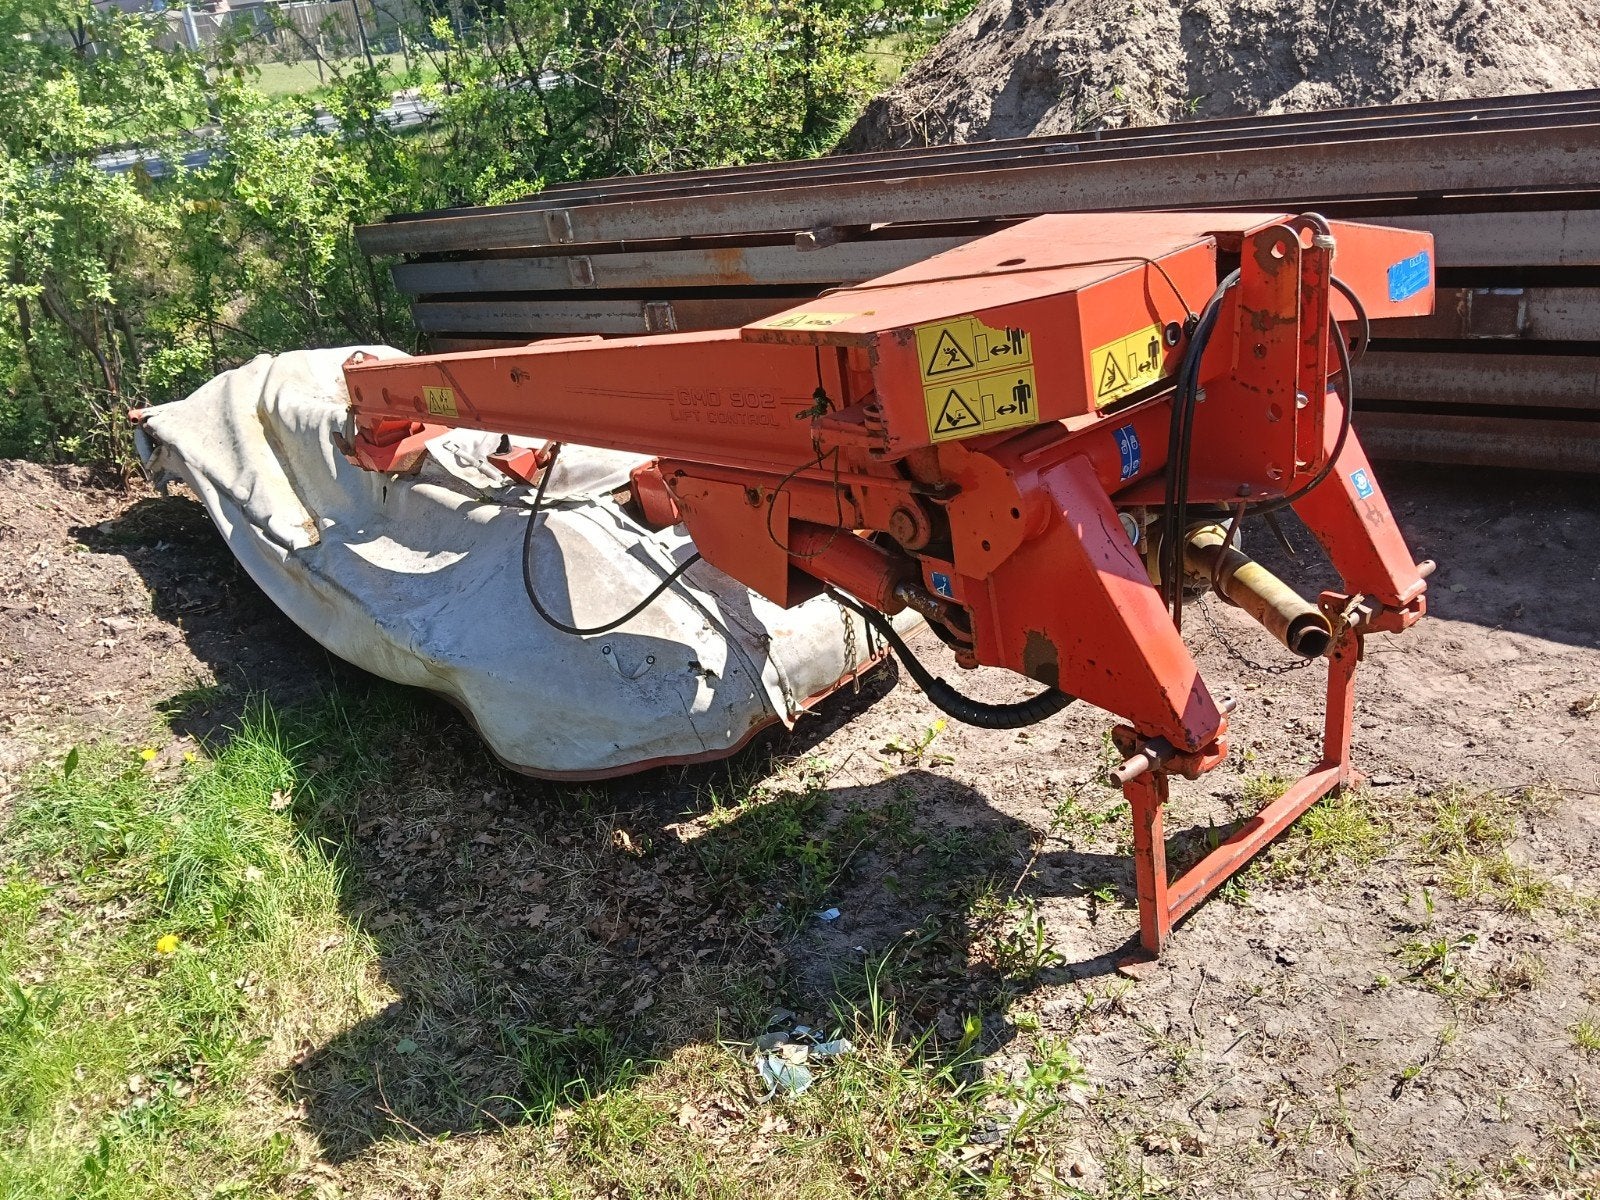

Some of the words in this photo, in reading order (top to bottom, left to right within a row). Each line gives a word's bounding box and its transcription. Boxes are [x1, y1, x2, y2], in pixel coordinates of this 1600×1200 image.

[678, 390, 721, 407] GMD
[729, 392, 776, 409] 902
[670, 409, 701, 422] LIFT
[707, 411, 780, 427] CONTROL
